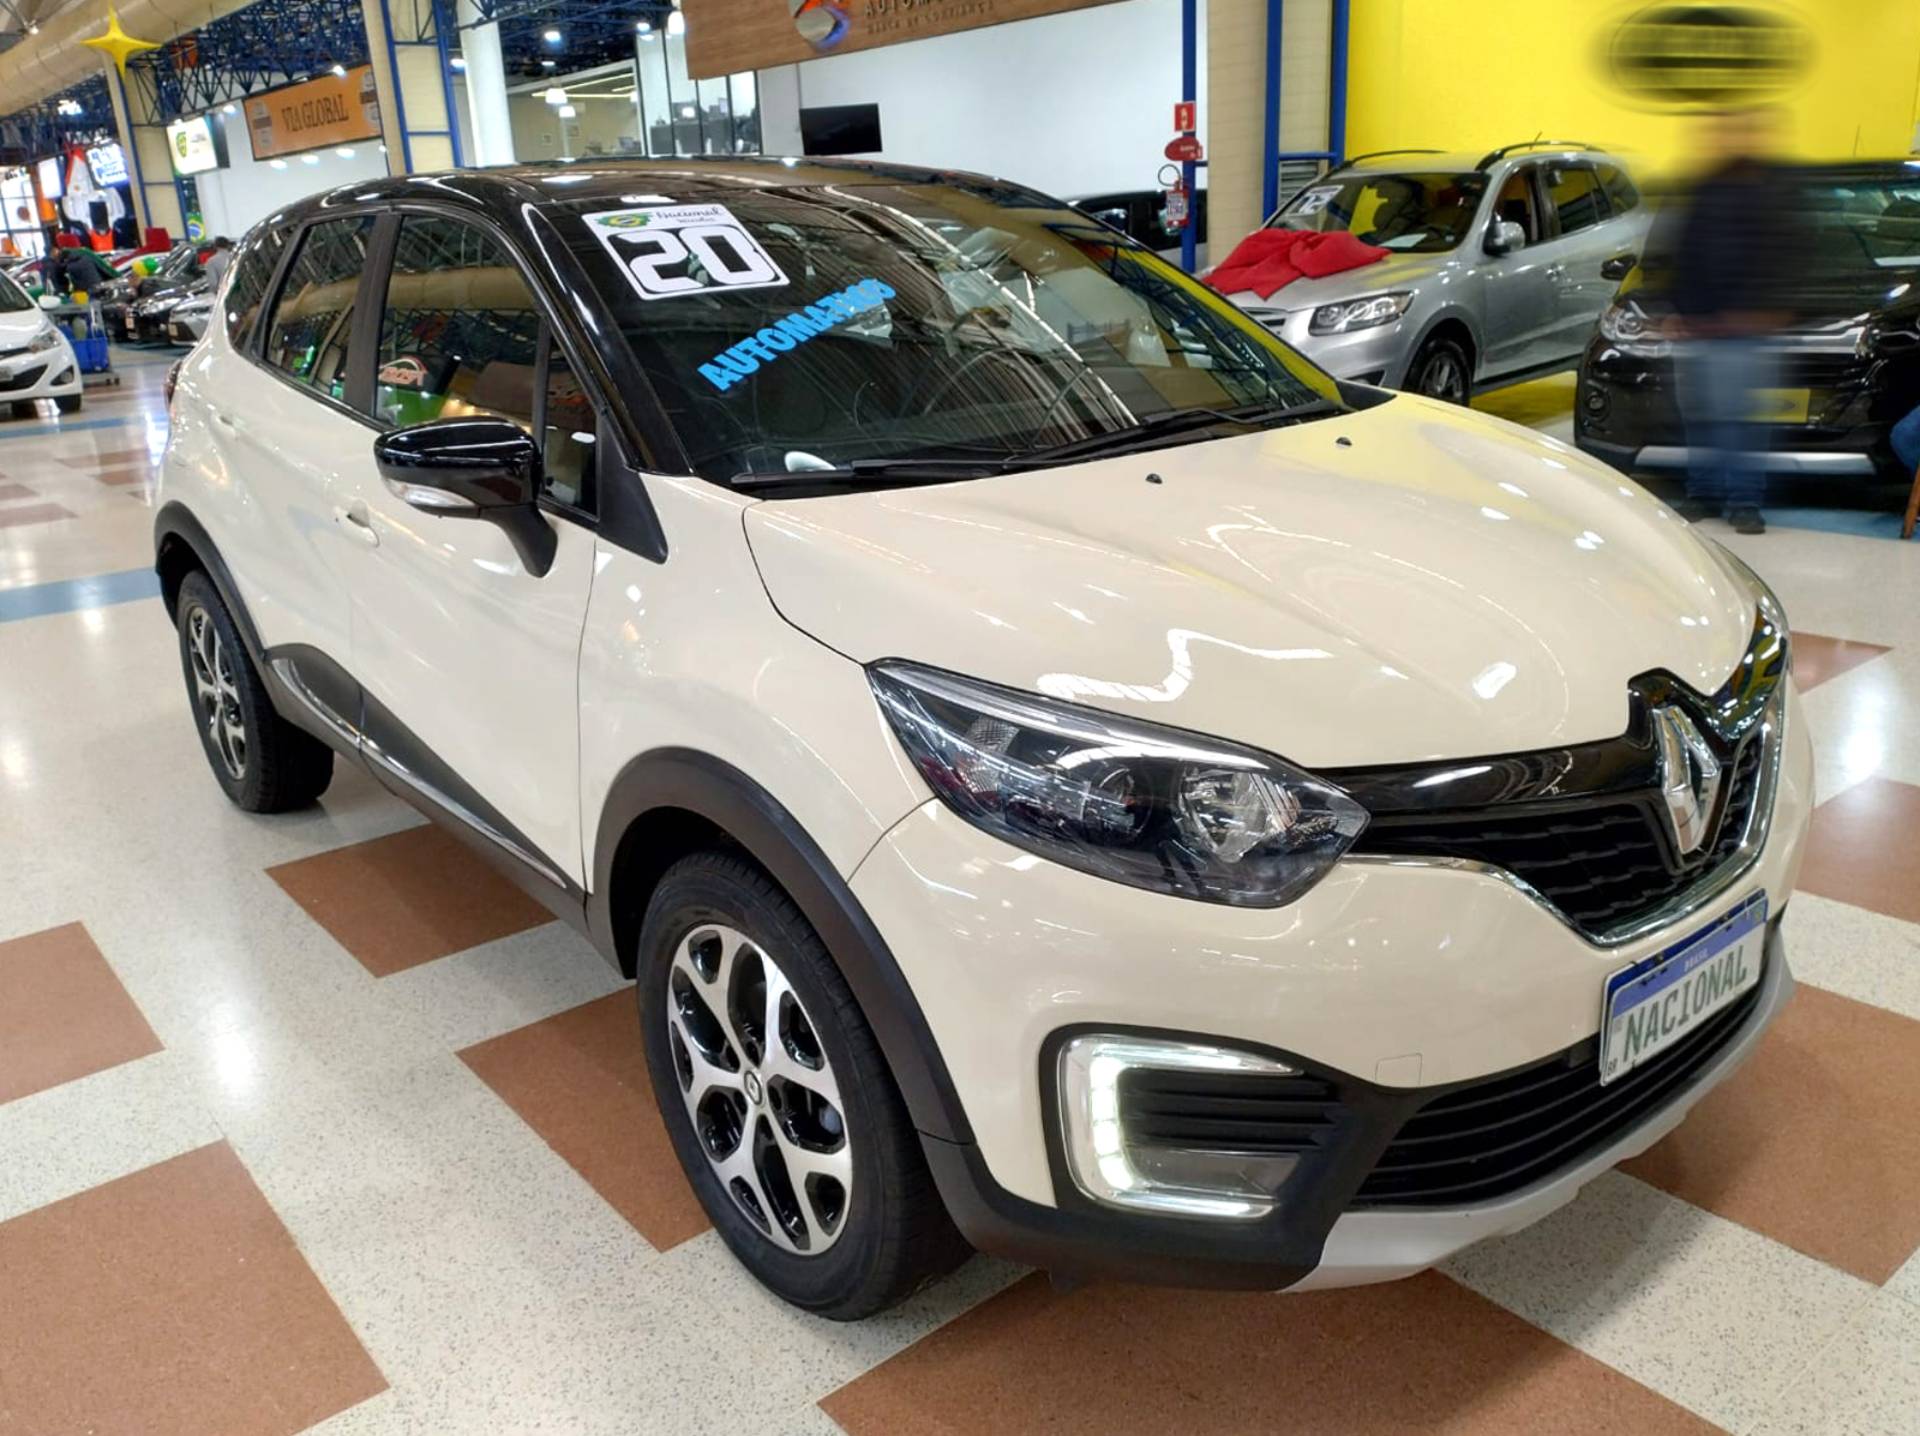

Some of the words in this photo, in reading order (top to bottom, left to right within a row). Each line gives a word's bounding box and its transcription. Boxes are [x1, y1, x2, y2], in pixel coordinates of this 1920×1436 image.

[302, 94, 350, 129] GLOBAL
[614, 225, 777, 293] 20
[1623, 945, 1748, 1062] NACIONAL
